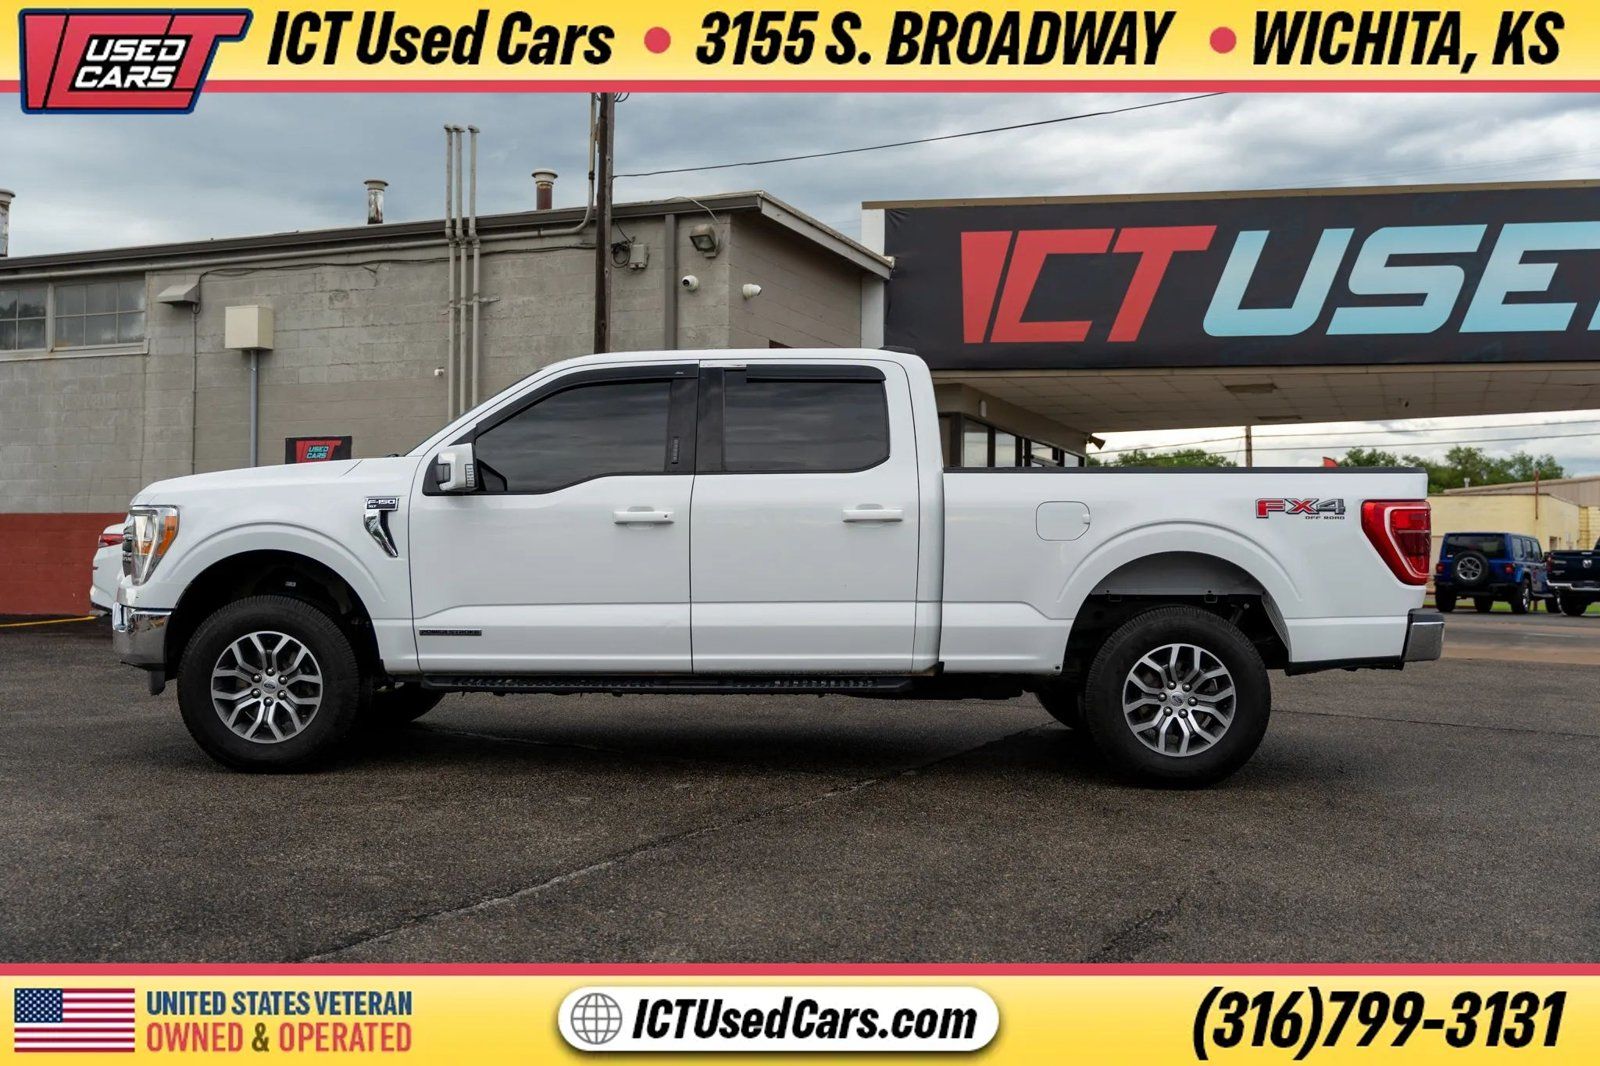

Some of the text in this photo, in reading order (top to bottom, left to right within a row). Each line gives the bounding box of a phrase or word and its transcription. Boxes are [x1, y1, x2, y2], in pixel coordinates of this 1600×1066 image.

[961, 219, 1600, 343] ICT USE
[1255, 498, 1346, 519] FX4
